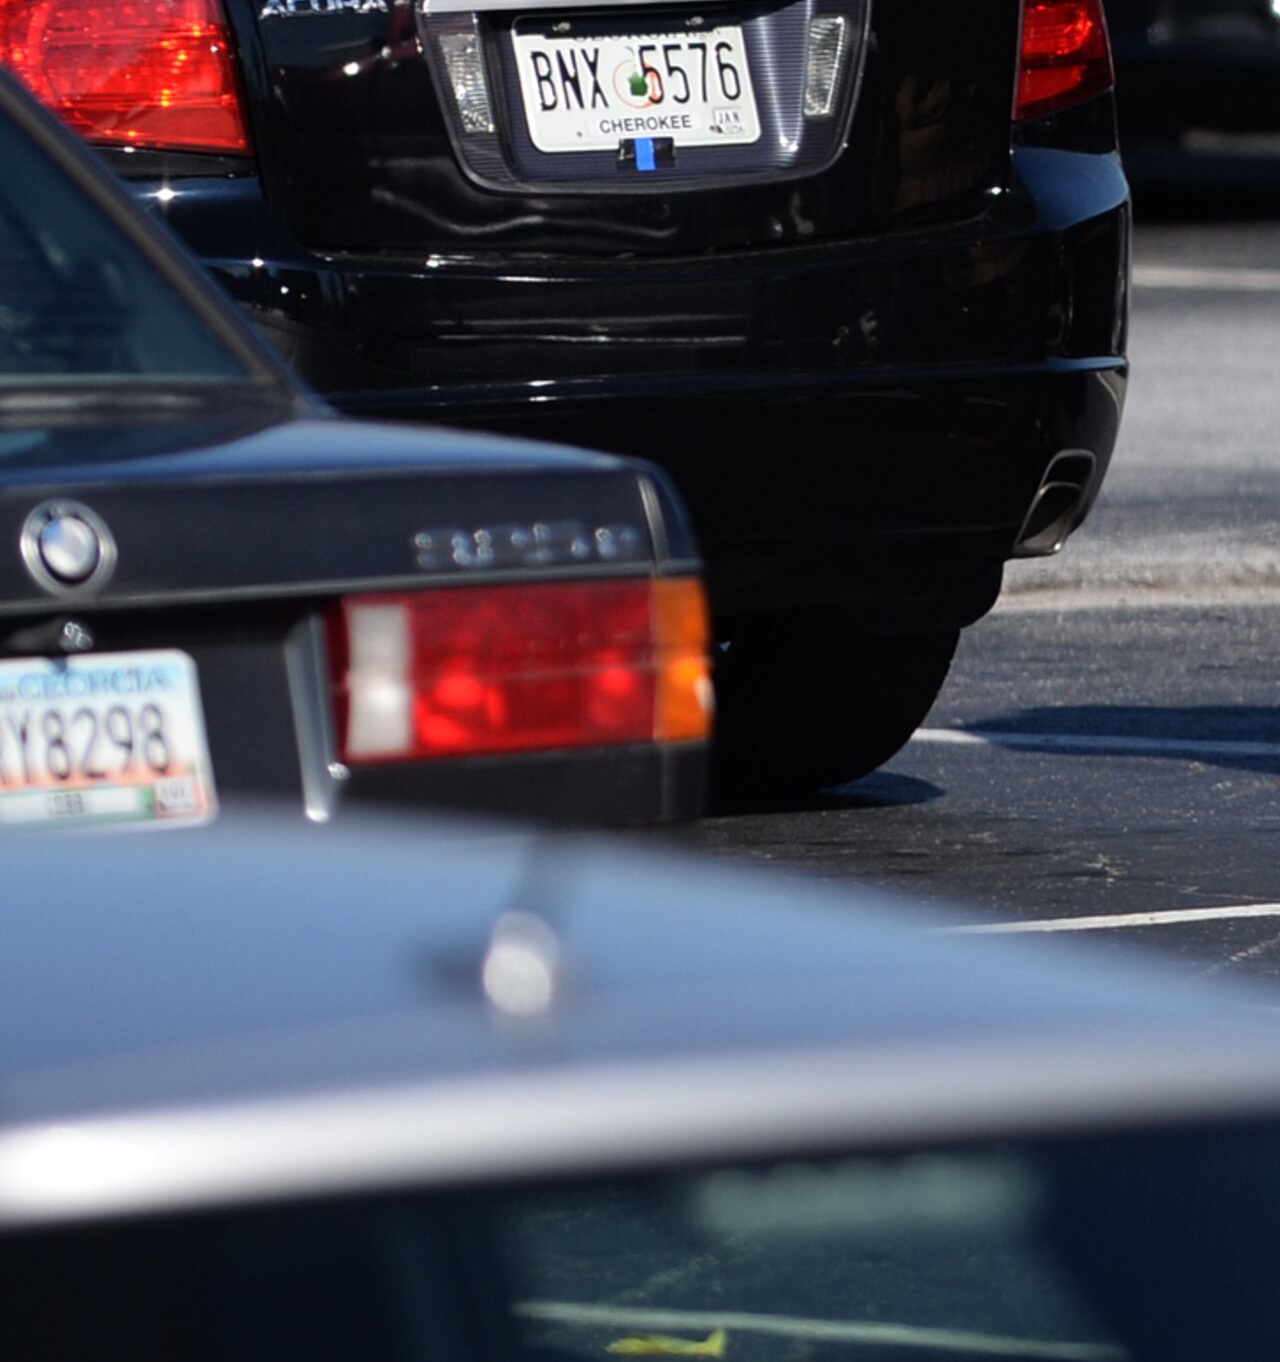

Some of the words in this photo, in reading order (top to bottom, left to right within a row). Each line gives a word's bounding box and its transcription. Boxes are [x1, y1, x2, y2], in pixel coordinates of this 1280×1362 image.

[530, 47, 610, 112] BNX
[637, 41, 742, 105] 5576
[599, 114, 693, 134] CHEROKEE
[0, 703, 169, 785] Y8298
